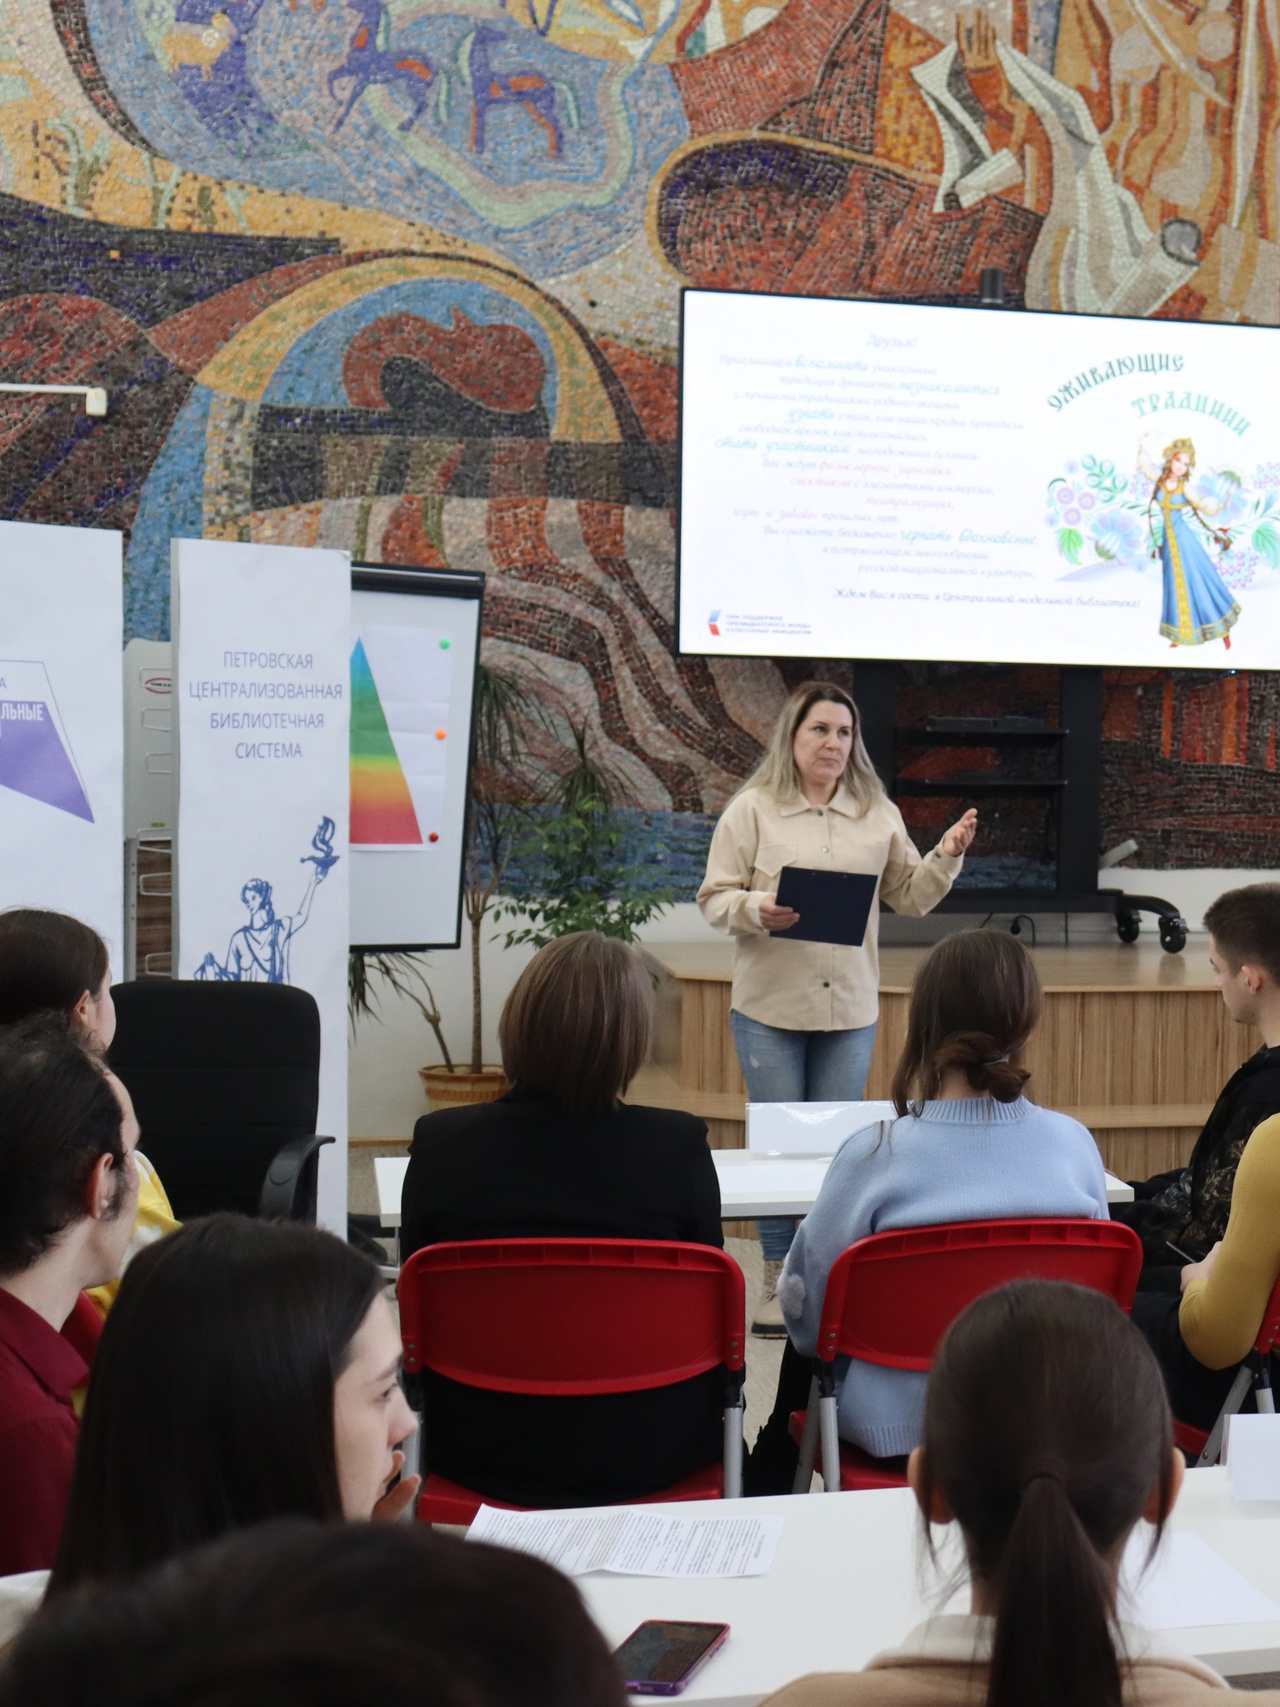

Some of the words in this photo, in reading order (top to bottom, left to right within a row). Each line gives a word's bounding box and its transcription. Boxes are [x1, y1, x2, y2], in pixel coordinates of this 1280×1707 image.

[866, 333, 918, 349] Друзья!
[719, 353, 793, 367] Приглашаем
[795, 353, 869, 371] вспомнить
[1047, 353, 1184, 413] ОЖИВАЮЩИЕ
[785, 407, 834, 423] узнать
[1131, 390, 1251, 437] ТРАДИЦИИ
[714, 437, 758, 450] стать
[762, 438, 850, 456] участником
[900, 529, 951, 546] черпать
[958, 528, 1038, 545] вдохновение
[869, 589, 889, 600] Вас
[942, 591, 1014, 604] Центральной
[1016, 593, 1073, 605] модельной
[224, 651, 313, 669] ПЕТРОВСКАЯ
[189, 681, 342, 701] ЦЕНТРАЛИЗОВАННАЯ
[210, 712, 324, 729] БИБЛИОТЕЧНАЯ
[235, 742, 302, 759] СИСТЕМА
